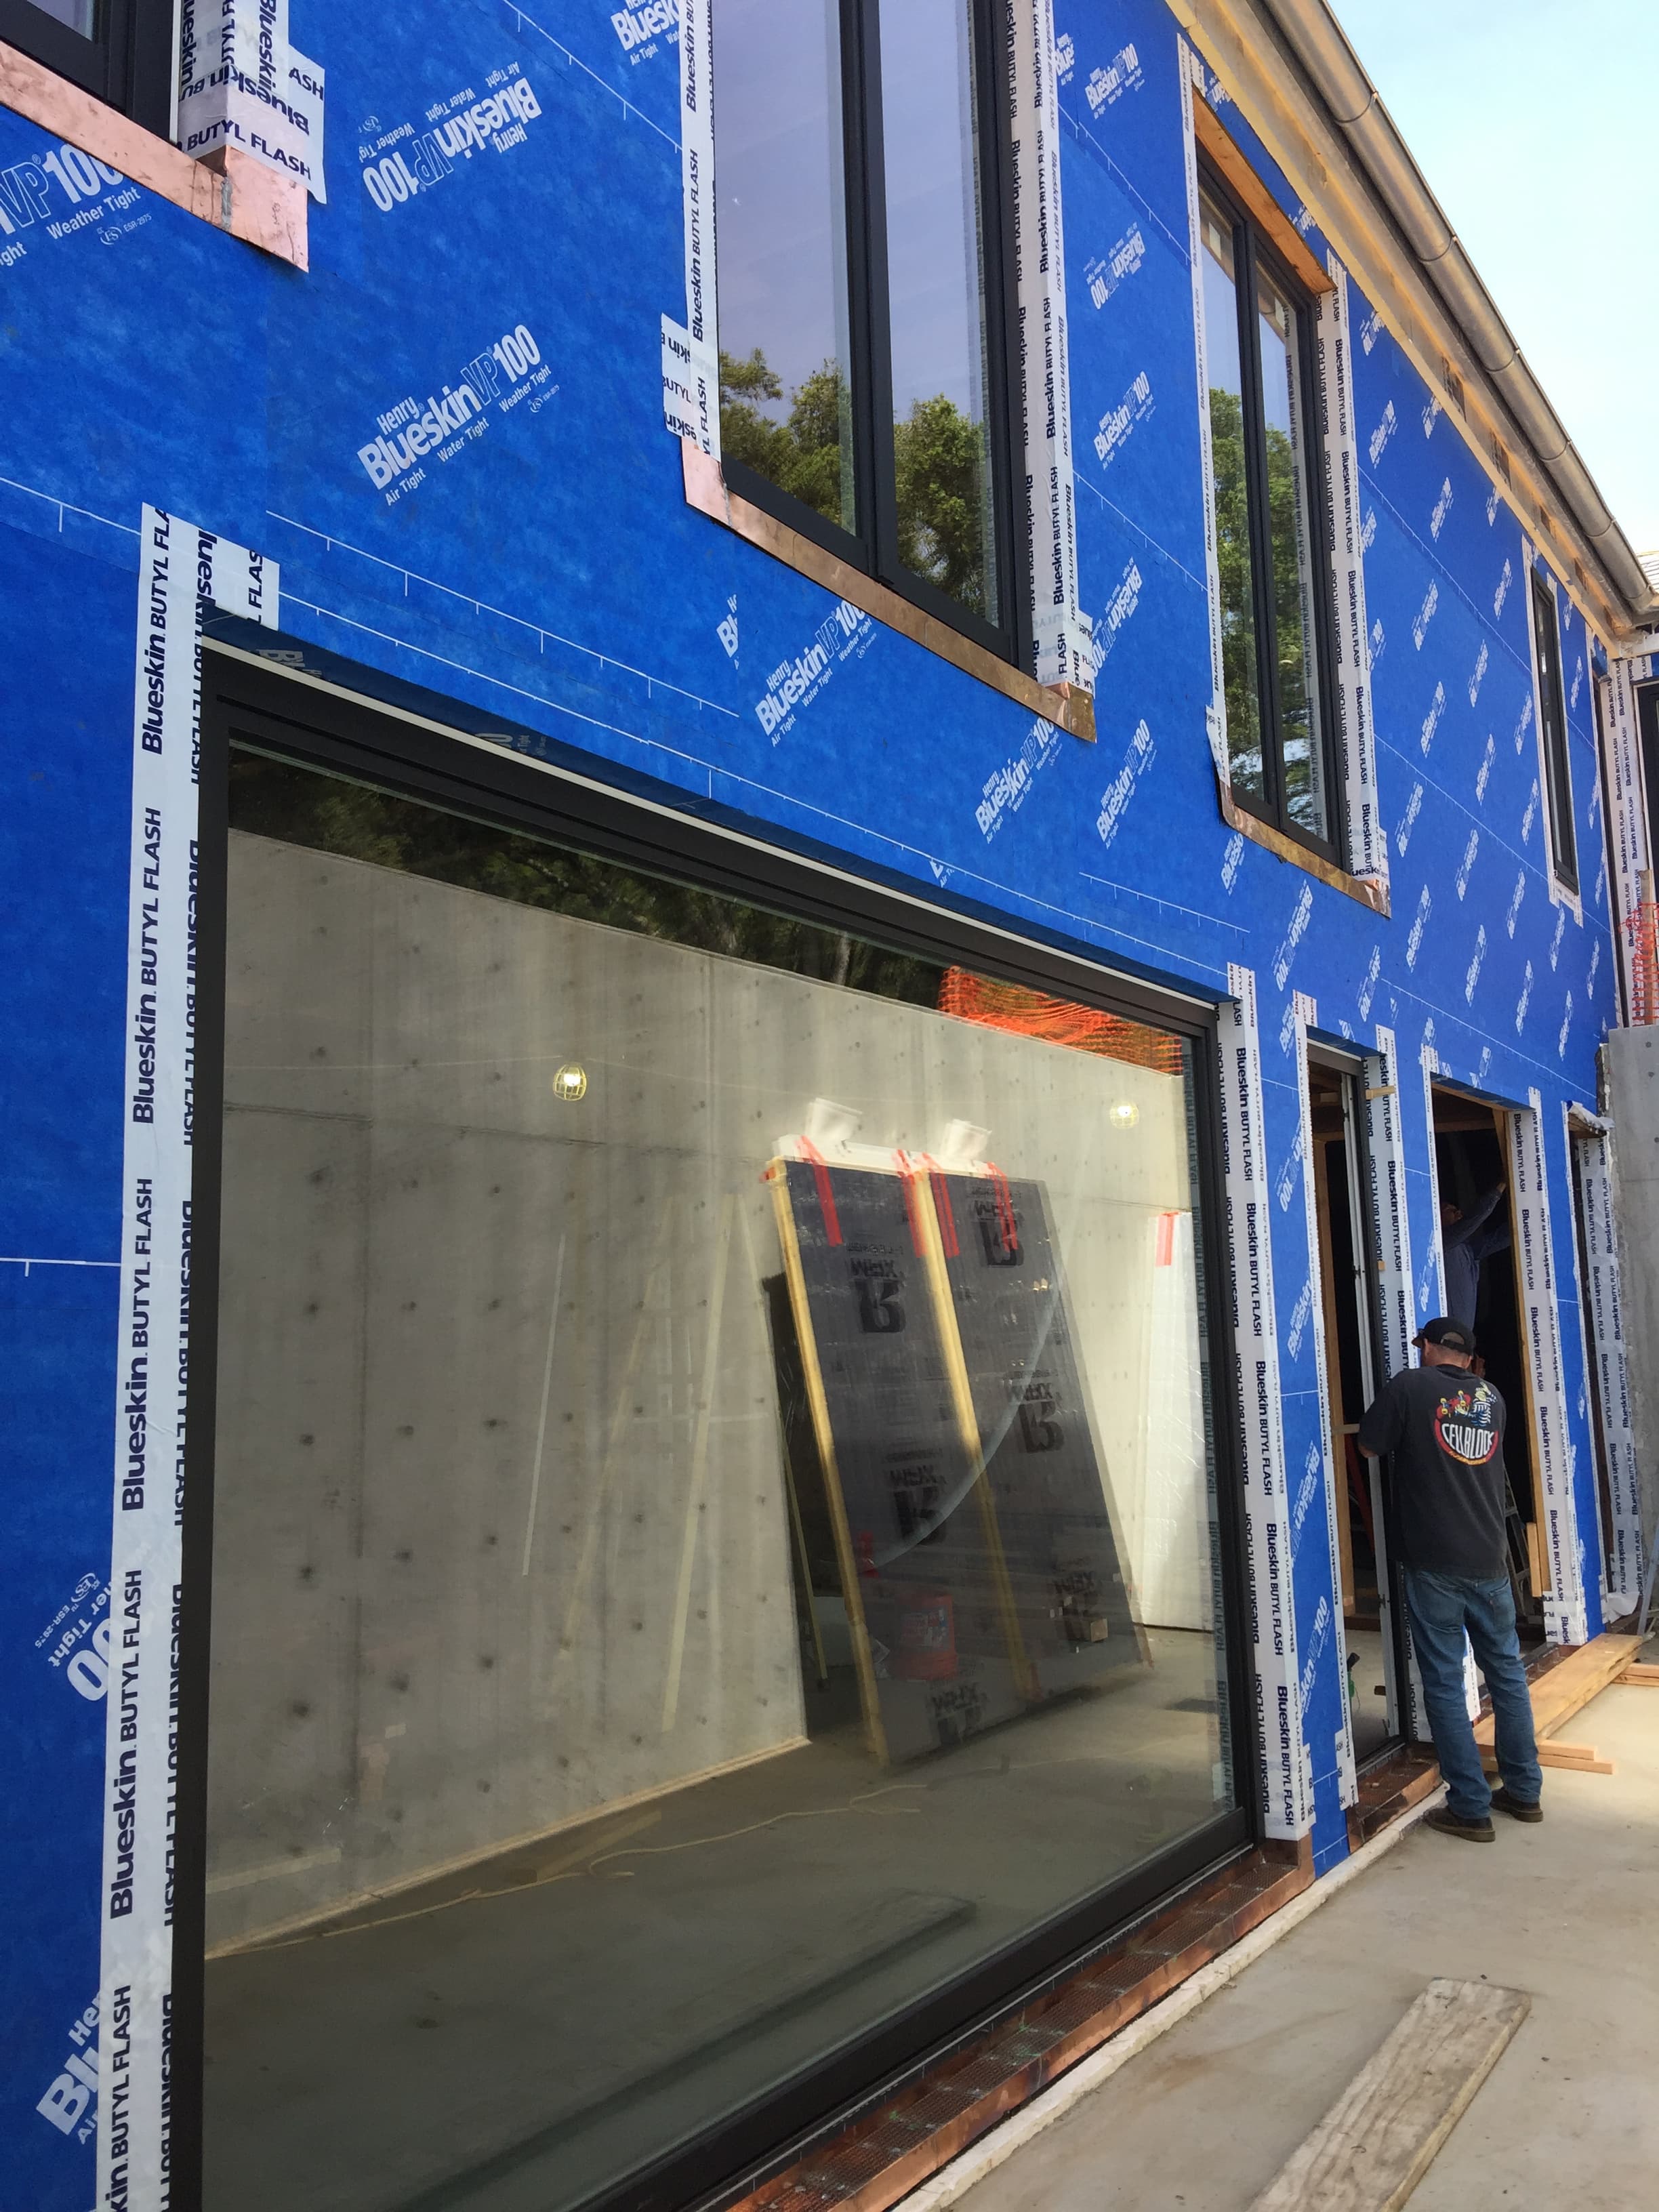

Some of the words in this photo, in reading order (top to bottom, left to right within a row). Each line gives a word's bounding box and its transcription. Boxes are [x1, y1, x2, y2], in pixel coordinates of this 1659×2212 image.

[182, 0, 197, 86] ueskin
[630, 53, 640, 66] Air
[640, 43, 659, 59] Tight
[485, 68, 508, 88] Tight
[507, 62, 520, 74] Air
[684, 25, 697, 112] Blueskin
[425, 101, 451, 122] Tight
[450, 87, 476, 108] Water
[188, 119, 245, 150] BUTYL
[251, 133, 311, 180] FLASH
[376, 122, 415, 150] Weather
[690, 150, 699, 205] FLASH
[46, 205, 104, 239] Weather
[103, 187, 141, 211] Tight
[691, 207, 701, 255] BUTYL
[691, 260, 703, 342] Blueskin
[1335, 339, 1344, 387] Blueskin
[499, 382, 532, 413] Weather
[530, 364, 552, 387] Tight
[698, 376, 708, 433] FLASH
[1044, 371, 1056, 440] Blueskin
[437, 438, 466, 463] Water
[465, 416, 489, 441] Tight
[385, 487, 401, 506] Air
[398, 467, 426, 493] Tight
[1341, 451, 1350, 495] Blueskin
[1052, 506, 1061, 540] BUTYL
[150, 556, 169, 630] BUTYL
[1052, 542, 1065, 606] Blueskin
[1348, 570, 1357, 613] Blueskin
[838, 634, 859, 661] Weather
[857, 618, 872, 637] Tight
[1057, 632, 1067, 675] FLASH
[1352, 638, 1360, 668] FLASH
[142, 633, 166, 755] Blueskin
[802, 686, 819, 708] Water
[817, 668, 833, 688] Tight
[1355, 686, 1364, 730] Blueskin
[771, 733, 781, 747] Air
[779, 714, 796, 736] Tight
[1359, 758, 1368, 785] FLASH
[143, 807, 161, 891] FLASH
[1361, 803, 1371, 851] Blueskin
[141, 897, 159, 987] BUTYL
[133, 998, 157, 1124] Blueskin
[1236, 1047, 1248, 1110] Blueskin
[1240, 1111, 1251, 1147] BUTYL
[1514, 1113, 1523, 1149] Blueskin
[1242, 1146, 1253, 1181] FLASH
[1387, 1160, 1397, 1213] Blueskin
[136, 1178, 153, 1256] FLASH
[1246, 1202, 1258, 1259] Blueskin
[1391, 1214, 1400, 1246] BUTYL
[1522, 1209, 1532, 1247] Blueskin
[1250, 1260, 1260, 1298] BUTYL
[1394, 1245, 1402, 1272] FLASH
[1525, 1248, 1533, 1268] BUTYL
[132, 1261, 151, 1348] BUTYL
[1252, 1300, 1263, 1337] FLASH
[1397, 1290, 1408, 1341] Blueskin
[1530, 1307, 1540, 1348] Blueskin
[1536, 1370, 1544, 1392] FLASH
[1256, 1360, 1268, 1416] Blueskin
[122, 1356, 148, 1511] Blueskin
[1260, 1417, 1271, 1455] BUTYL
[1441, 1423, 1494, 1459] CELLBLOCK
[1263, 1456, 1272, 1496] FLASH
[1266, 1523, 1278, 1580] Blueskin
[1550, 1509, 1559, 1549] Blueskin
[123, 1570, 142, 1649] FLASH
[1270, 1582, 1281, 1616] BUTYL
[47, 1618, 92, 1668] Tight
[1273, 1617, 1283, 1656] FLASH
[120, 1653, 139, 1742] BUTYL
[1277, 1685, 1290, 1752] Blueskin
[1281, 1752, 1292, 1789] BUTYL
[1284, 1787, 1294, 1826] FLASH
[110, 1749, 137, 1919] Blueskin
[112, 1985, 131, 2072] FLASH
[111, 2074, 129, 2160] BUTYL
